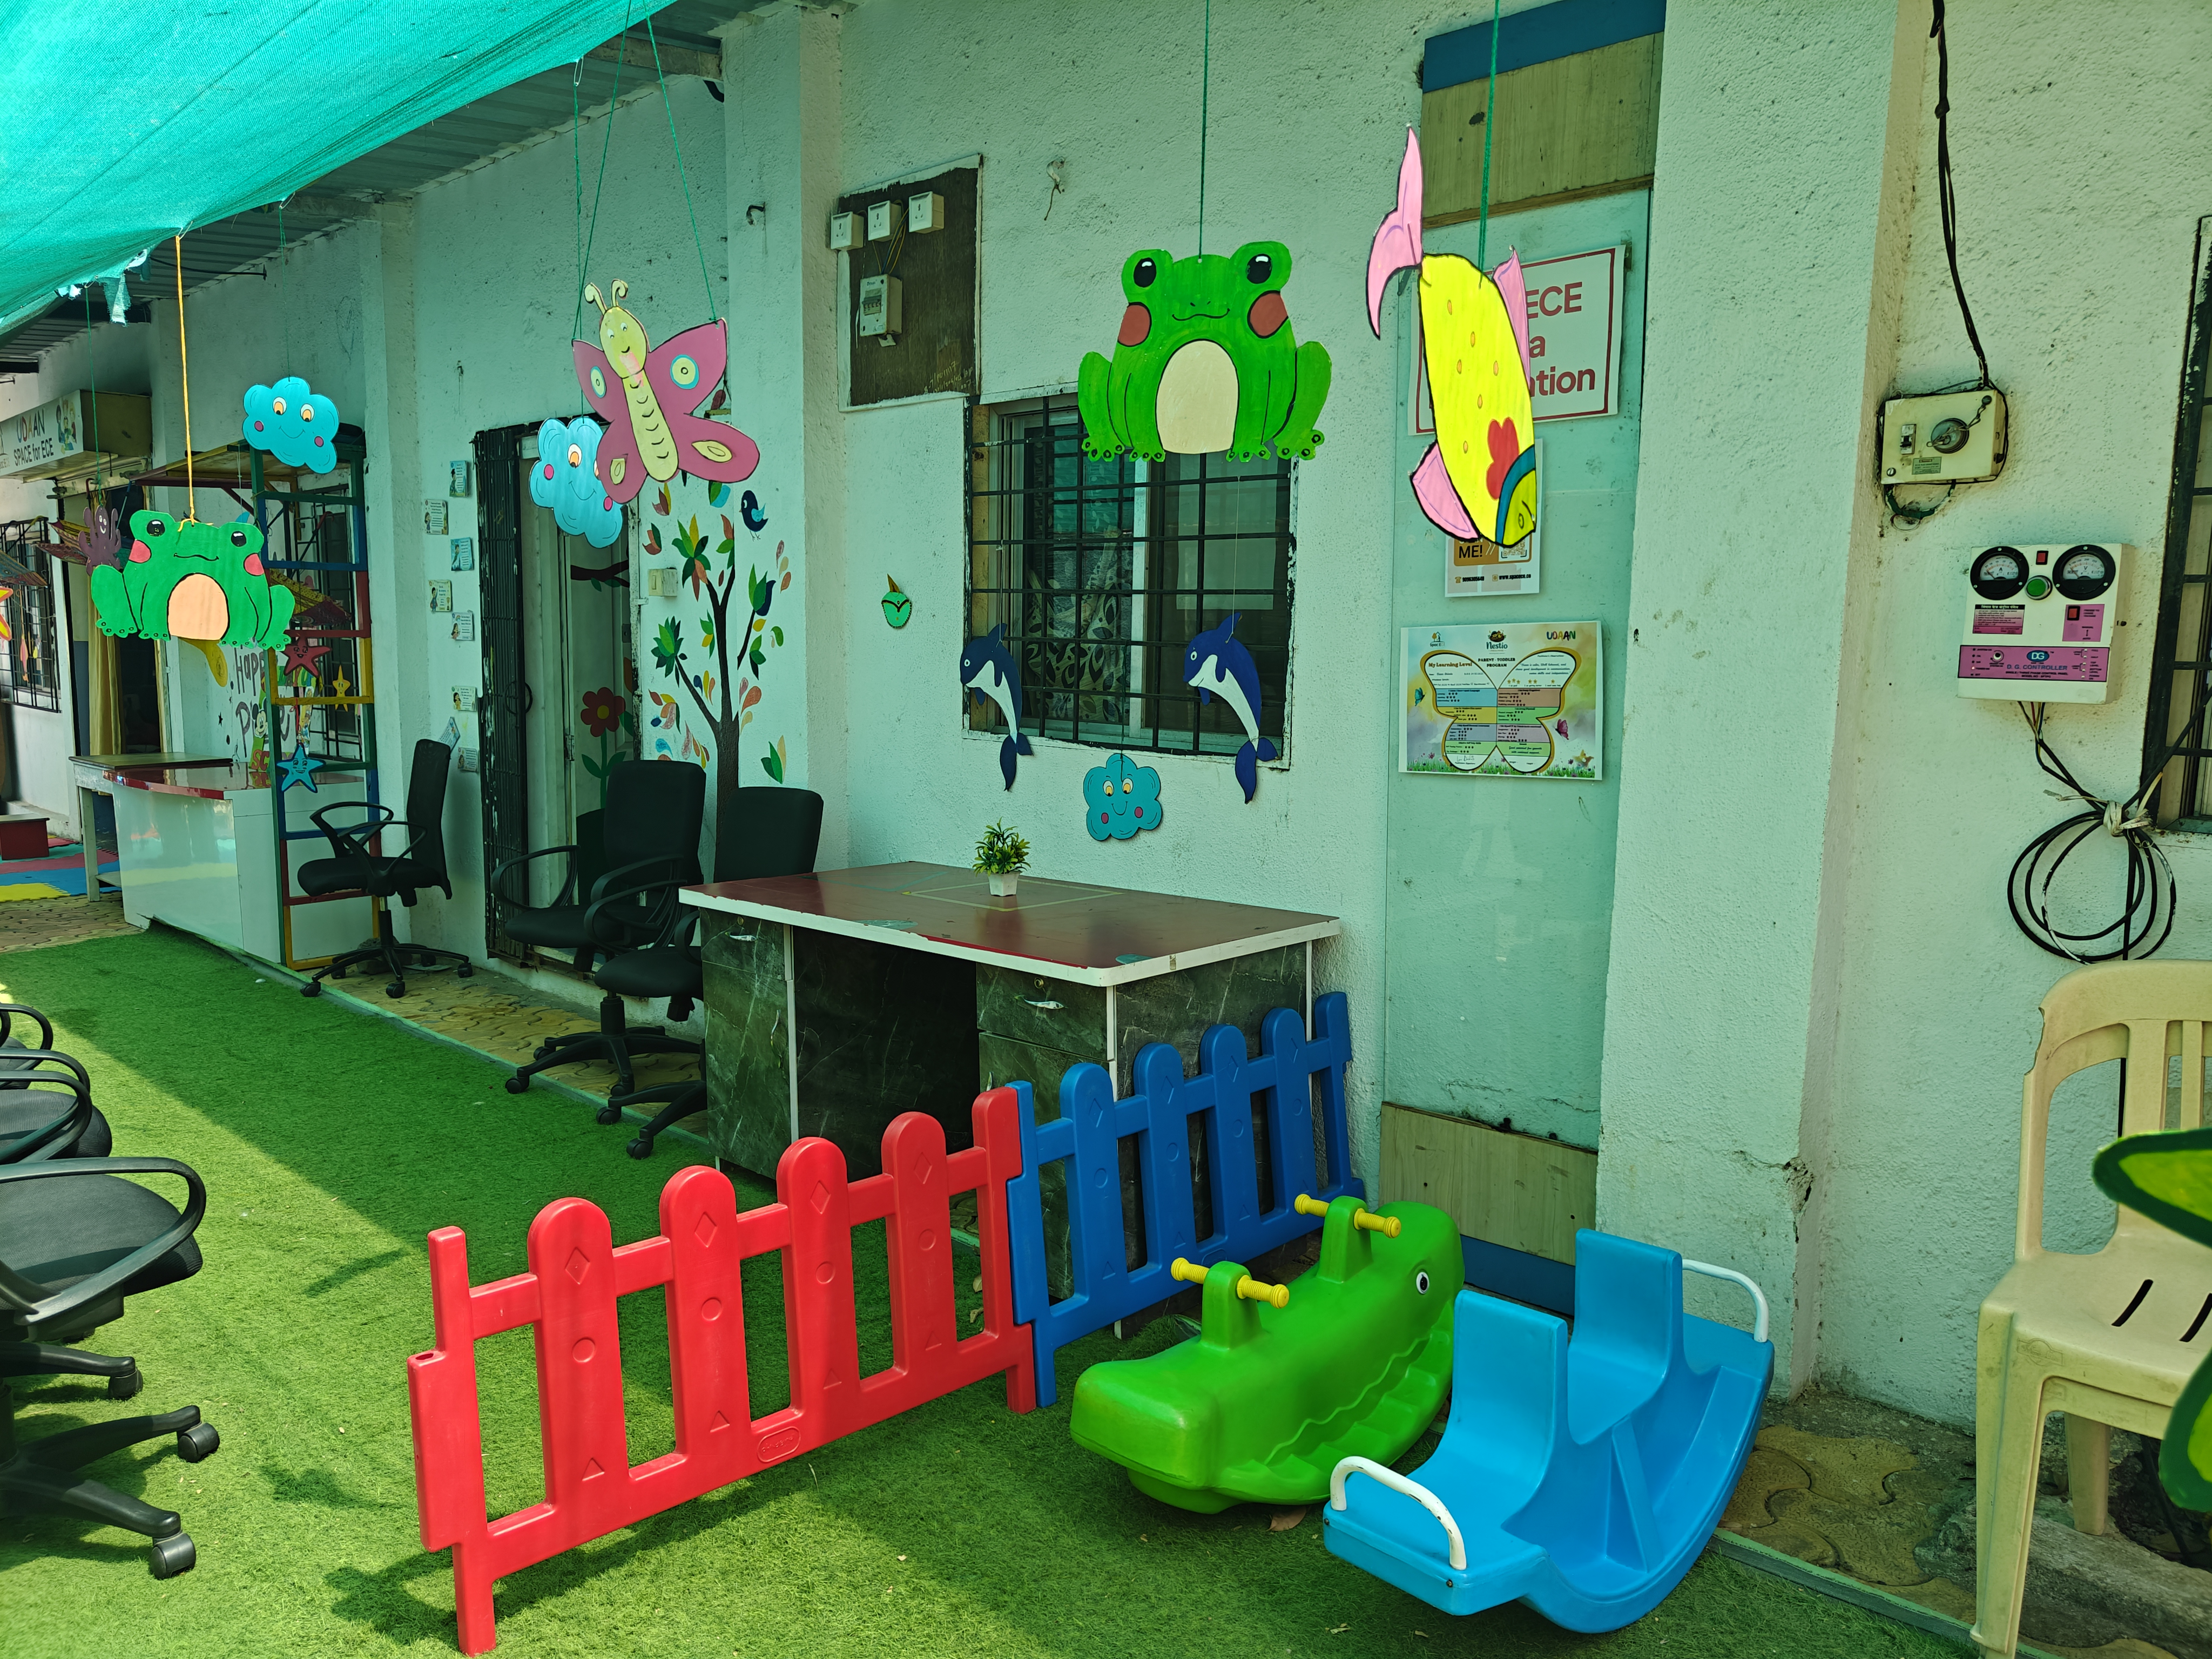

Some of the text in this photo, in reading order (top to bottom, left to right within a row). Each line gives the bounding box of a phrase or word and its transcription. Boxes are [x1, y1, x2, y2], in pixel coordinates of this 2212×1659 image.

[1526, 281, 1582, 319] ECE
[1529, 335, 1546, 359] a
[17, 408, 45, 443] UDAAN
[14, 445, 32, 466] SPACE
[41, 438, 54, 458] ECE
[1459, 545, 1482, 558] ME!
[1546, 631, 1576, 641] UDAAN
[234, 648, 265, 696] Happ
[251, 750, 269, 770] SC
